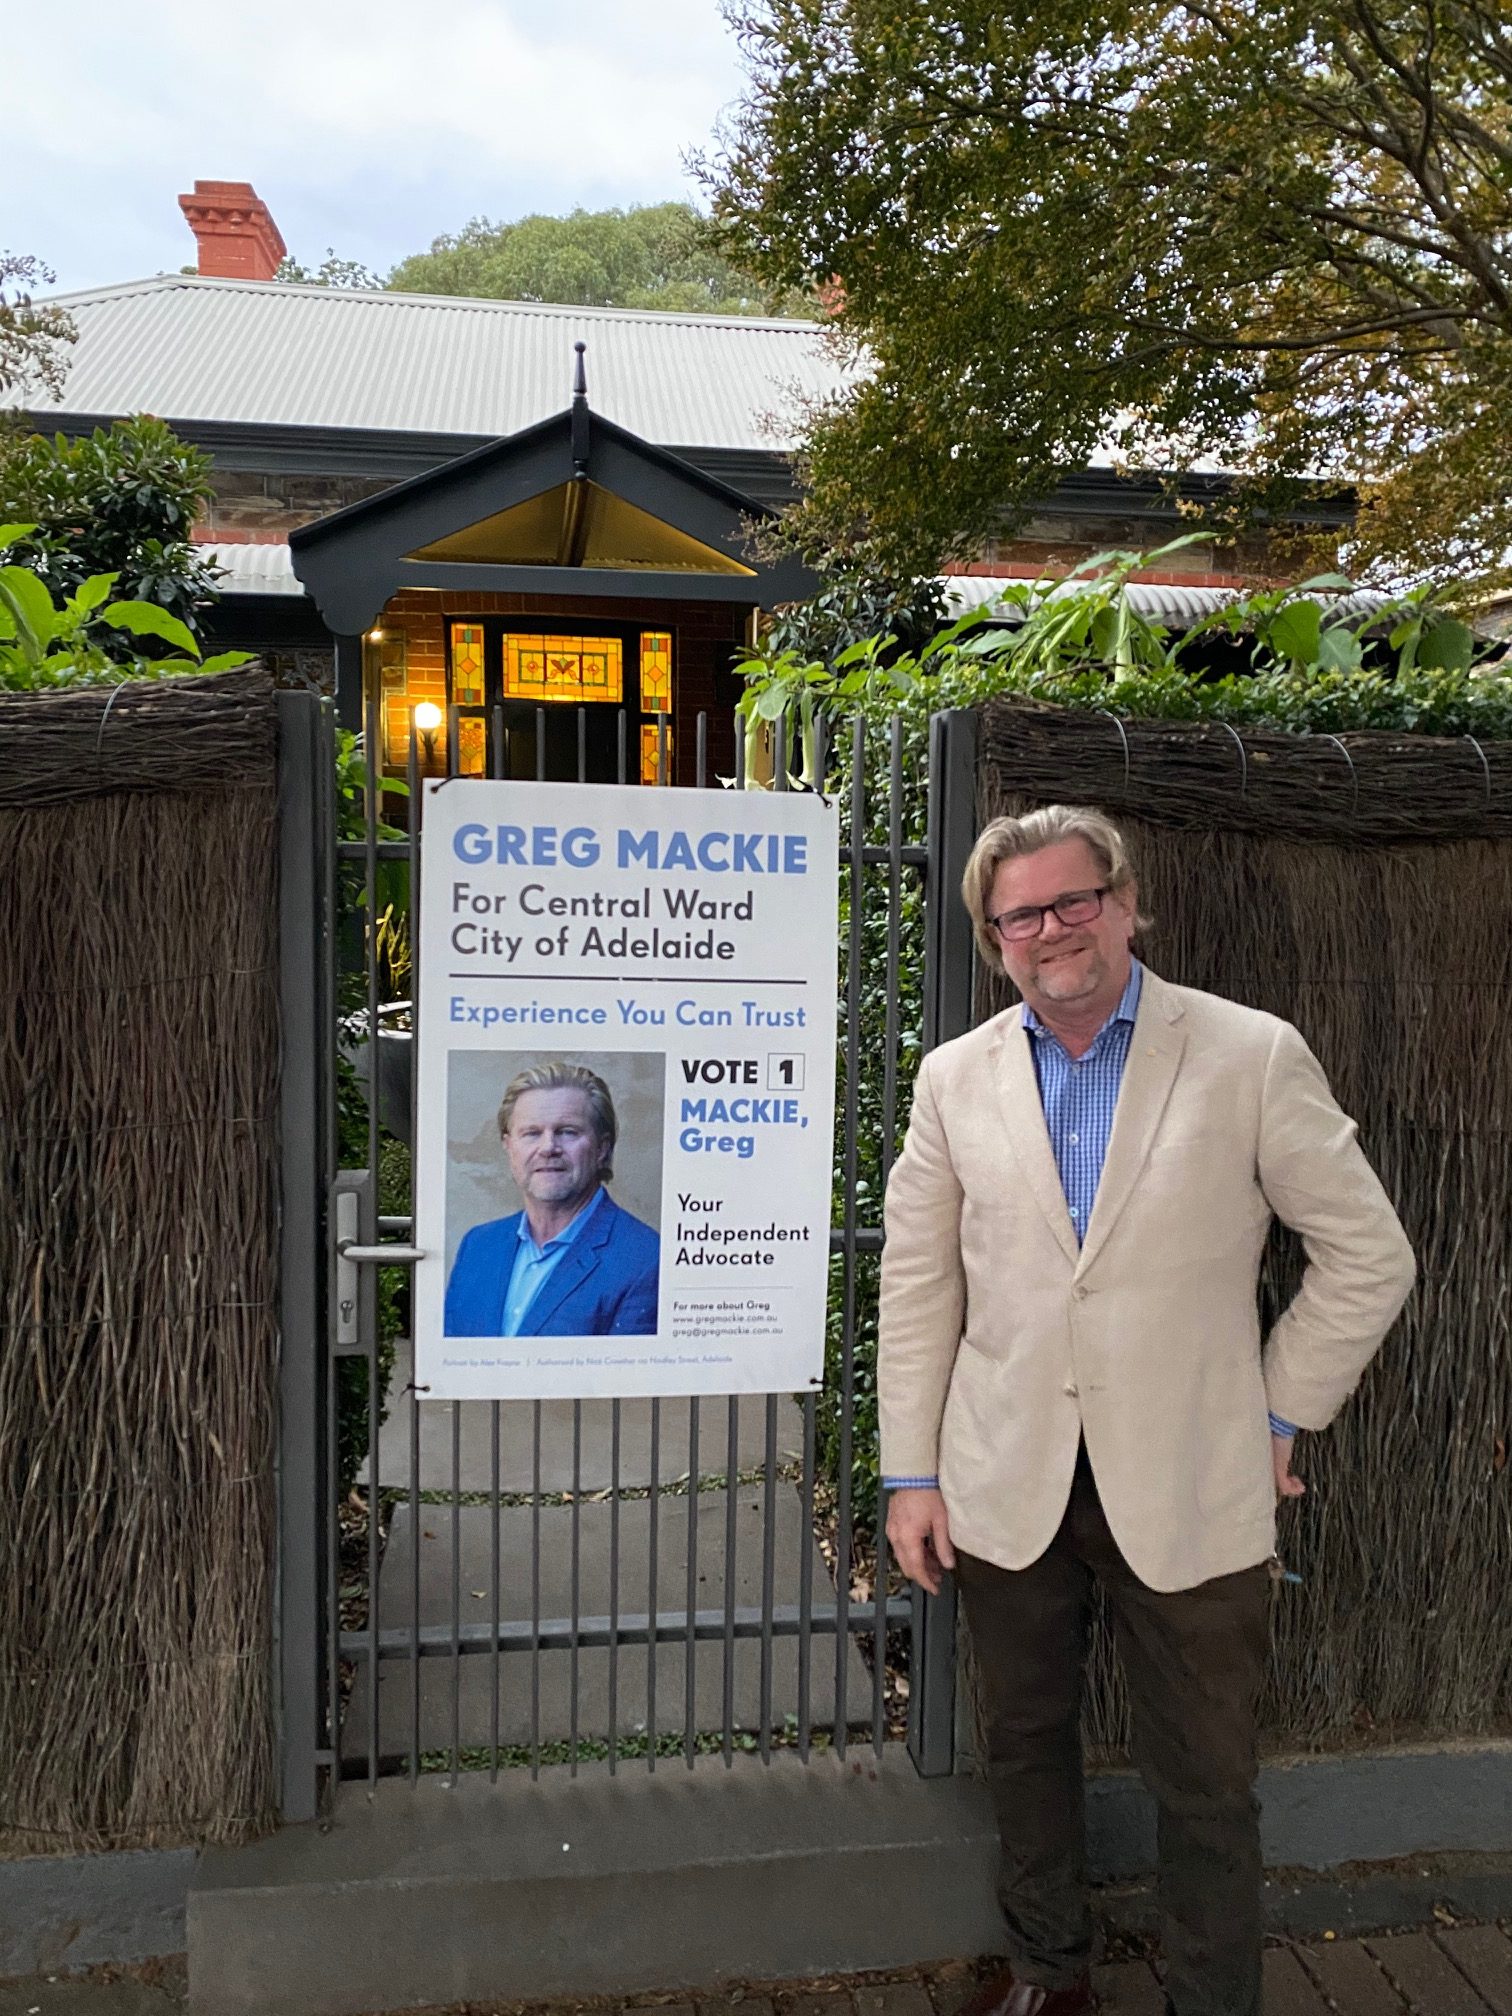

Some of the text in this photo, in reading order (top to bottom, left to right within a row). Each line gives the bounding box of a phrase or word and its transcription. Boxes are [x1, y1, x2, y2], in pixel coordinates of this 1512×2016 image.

[452, 824, 807, 874] GREG MACKIE
[452, 883, 753, 920] For Central Ward
[452, 923, 736, 962] City of Adelaide
[450, 997, 806, 1028] Experience You Can Trust
[681, 1060, 794, 1084] VOTE 1
[681, 1098, 809, 1128] MACKIE,
[680, 1128, 755, 1159] Greg
[678, 1194, 723, 1212] Your
[677, 1222, 810, 1245] Independent
[675, 1248, 775, 1266] Advocate
[673, 1301, 688, 1310] For
[717, 1301, 744, 1310] about
[746, 1300, 770, 1311] Greg
